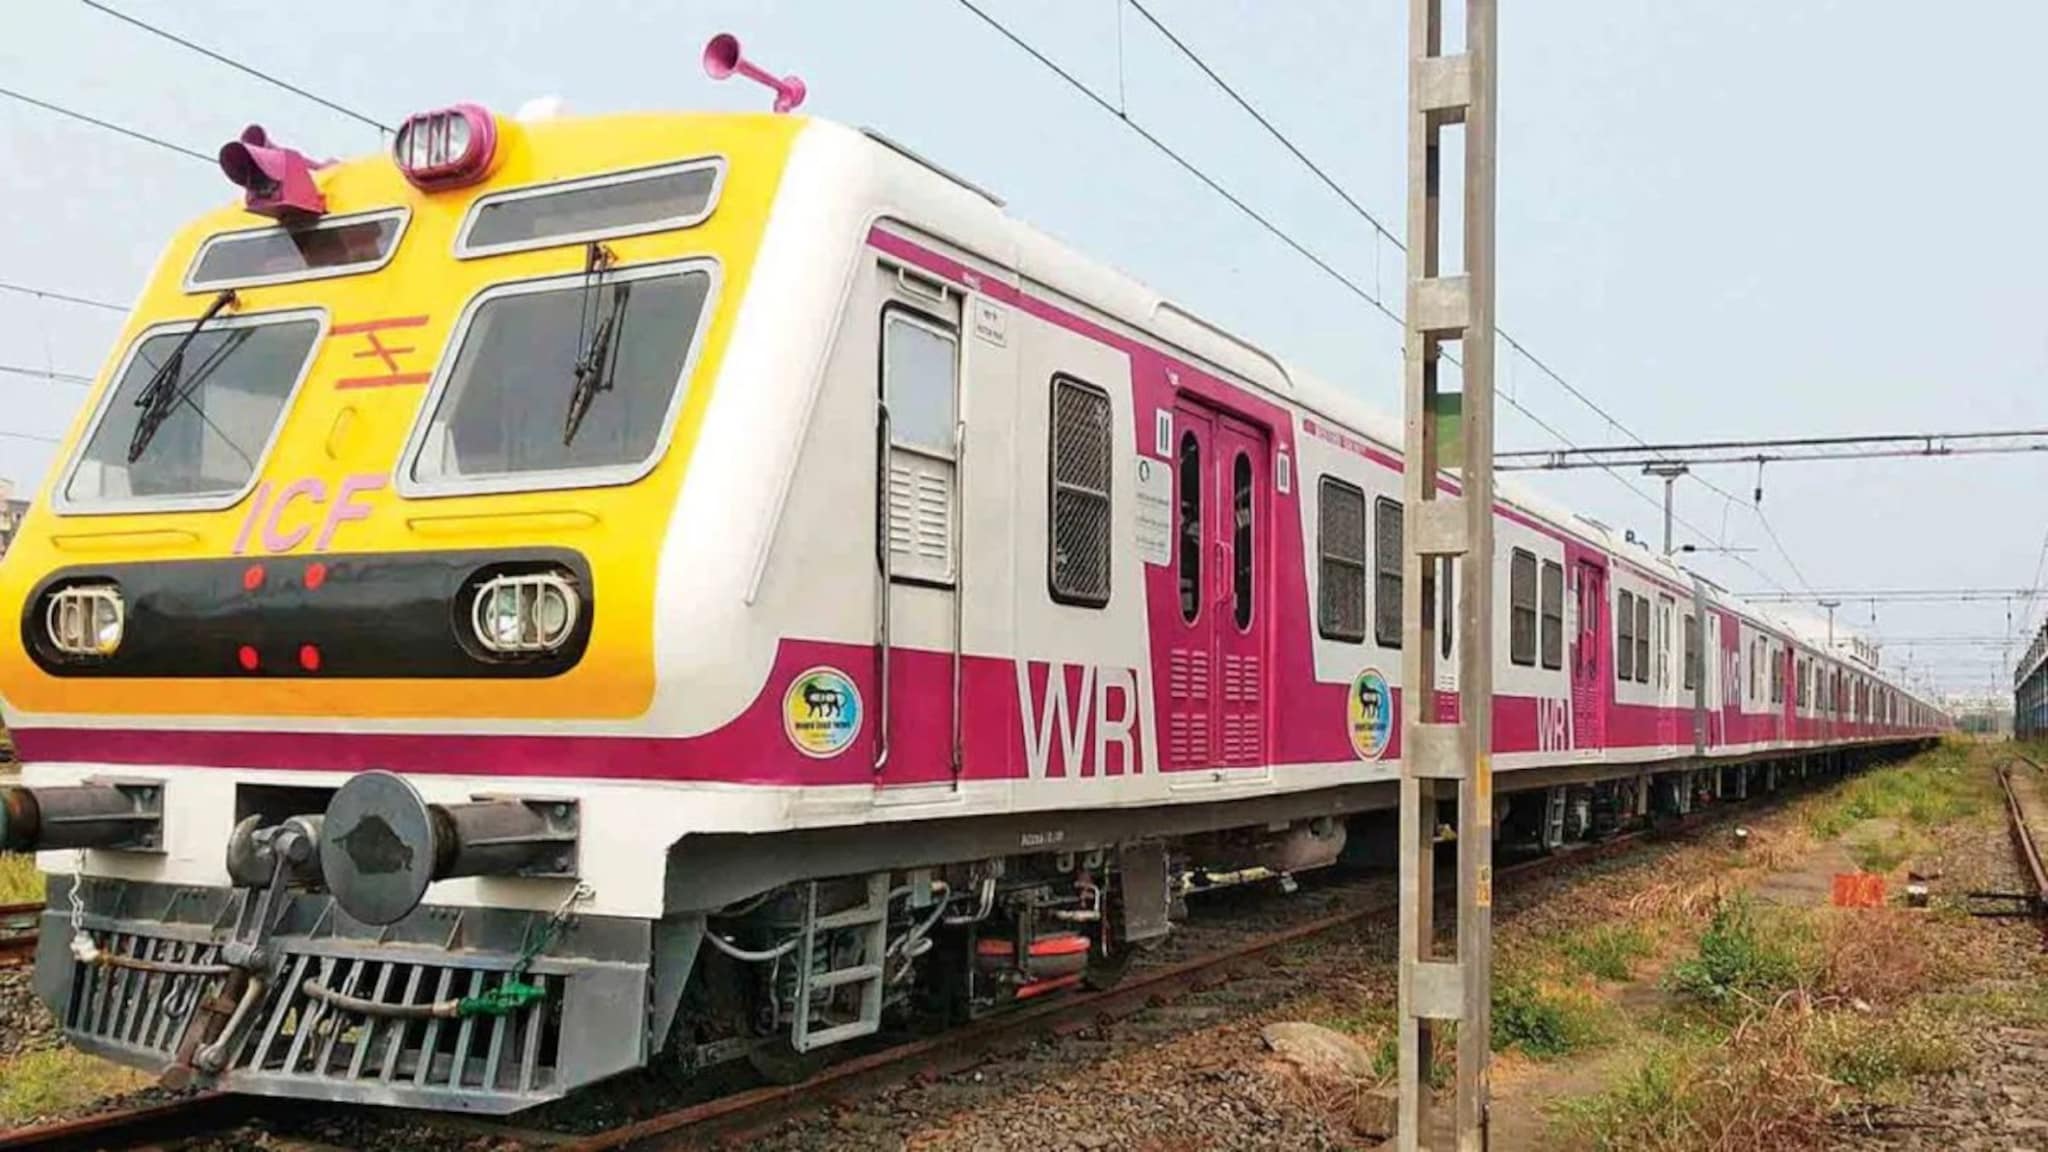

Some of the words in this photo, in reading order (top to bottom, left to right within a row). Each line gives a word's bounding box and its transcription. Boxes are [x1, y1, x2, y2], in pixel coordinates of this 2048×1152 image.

[232, 474, 387, 554] ICF
[1014, 659, 1136, 780] WR
[1537, 696, 1565, 752] WR
